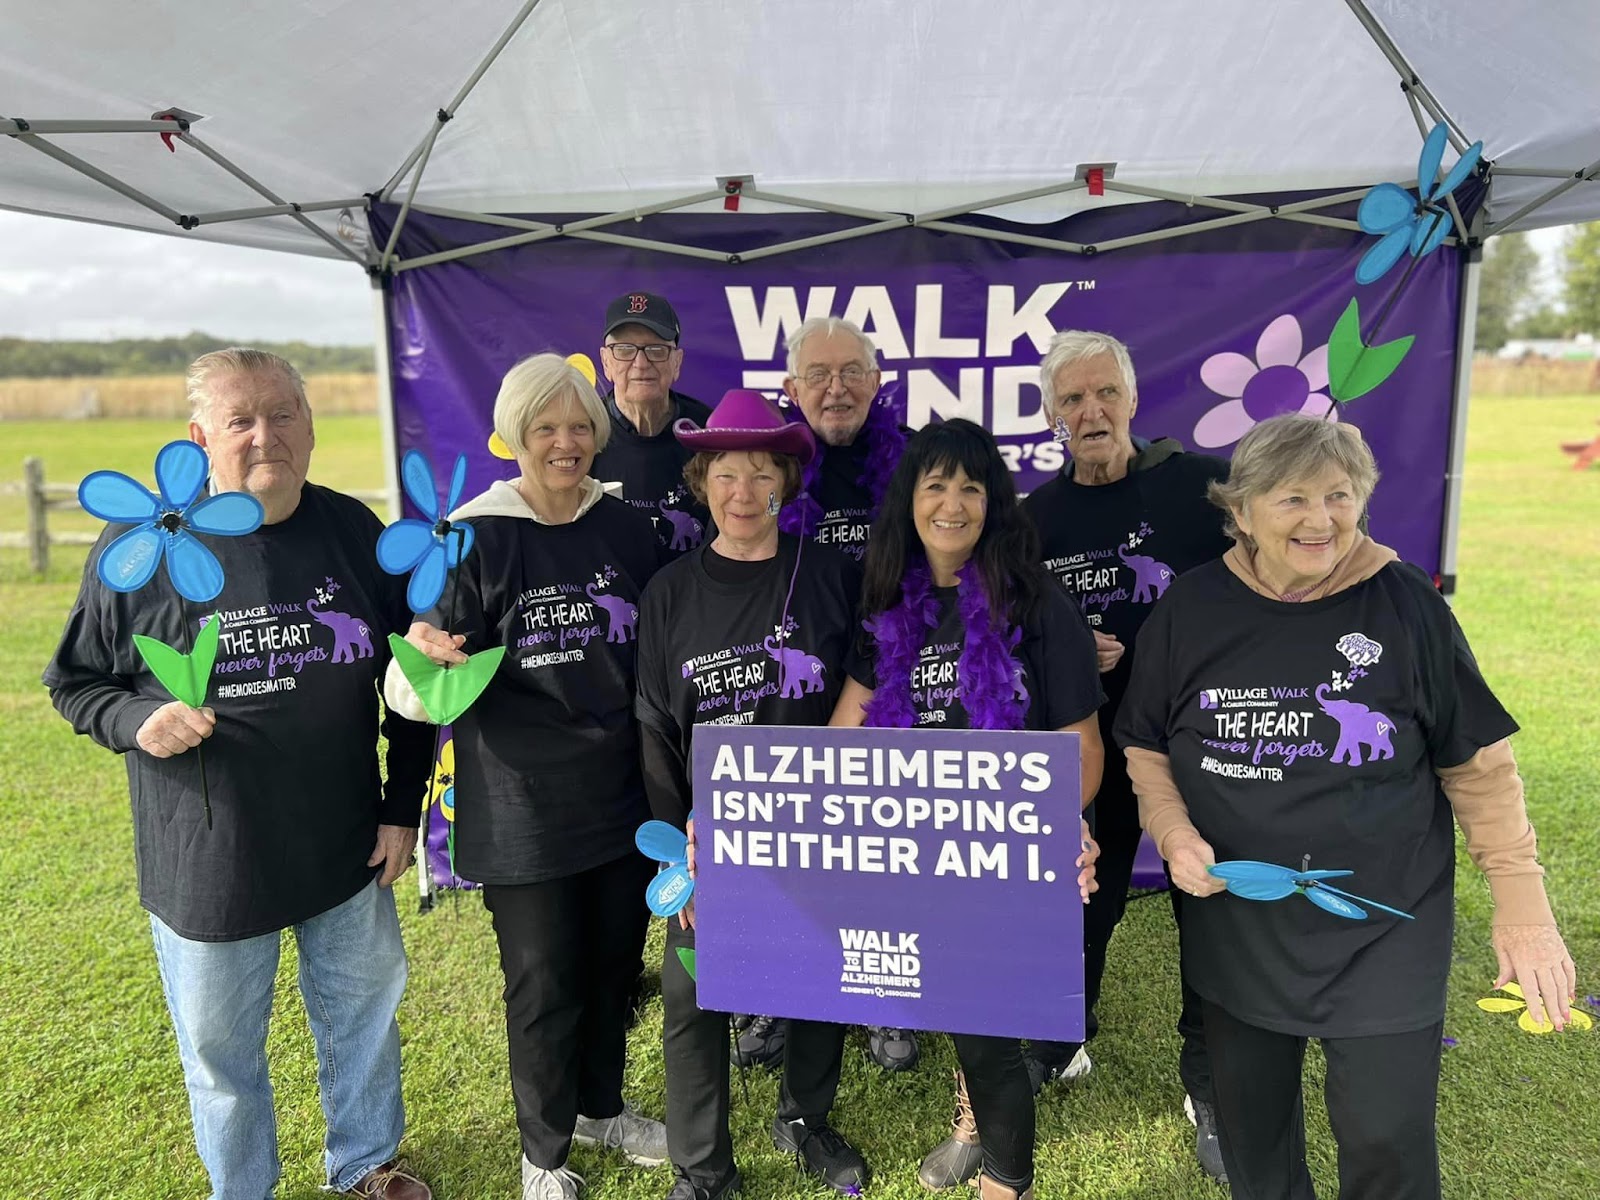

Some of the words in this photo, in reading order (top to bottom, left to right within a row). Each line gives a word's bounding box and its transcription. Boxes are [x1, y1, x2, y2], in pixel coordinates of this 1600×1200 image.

[627, 295, 648, 313] B
[725, 282, 1073, 361] WALK
[880, 365, 1049, 436] ND
[631, 500, 656, 508] WALK
[842, 508, 868, 517] WALK
[814, 527, 829, 544] HE
[832, 524, 871, 543] HEART
[1051, 554, 1086, 568] VILLAGE
[1086, 549, 1114, 560] WALK
[1076, 567, 1118, 592] HEART
[521, 586, 557, 602] VILLAGE
[218, 606, 268, 623] VILLAGE
[268, 603, 303, 615] WALK
[522, 606, 548, 630] THE
[550, 603, 594, 626] HEART
[219, 628, 255, 655] THE
[258, 624, 311, 650] HEART
[517, 630, 556, 648] never
[935, 642, 960, 654] WALK
[215, 655, 264, 674] never
[268, 646, 329, 677] forgets
[521, 649, 585, 669] #MEMORIESMATTER
[692, 649, 731, 667] VILLAGE
[732, 643, 764, 656] WALK
[218, 676, 296, 698] #MEMORIESMATTER
[693, 671, 722, 696] THE
[1216, 688, 1268, 701] VILLAGE
[1270, 686, 1309, 699] WALK
[1215, 711, 1247, 738] THE
[1251, 711, 1314, 737] HEART
[1252, 739, 1328, 766] forgets
[711, 744, 1052, 792] ALZHEIMER’S
[712, 790, 811, 824] ISN’T
[822, 794, 1052, 835] STOPPING.
[714, 829, 920, 875] NEITHER
[934, 840, 1009, 880] AM
[1027, 844, 1056, 882] I.
[839, 928, 920, 954] WALK
[863, 952, 920, 976] END
[840, 972, 921, 988] ALZHEIMER'S
